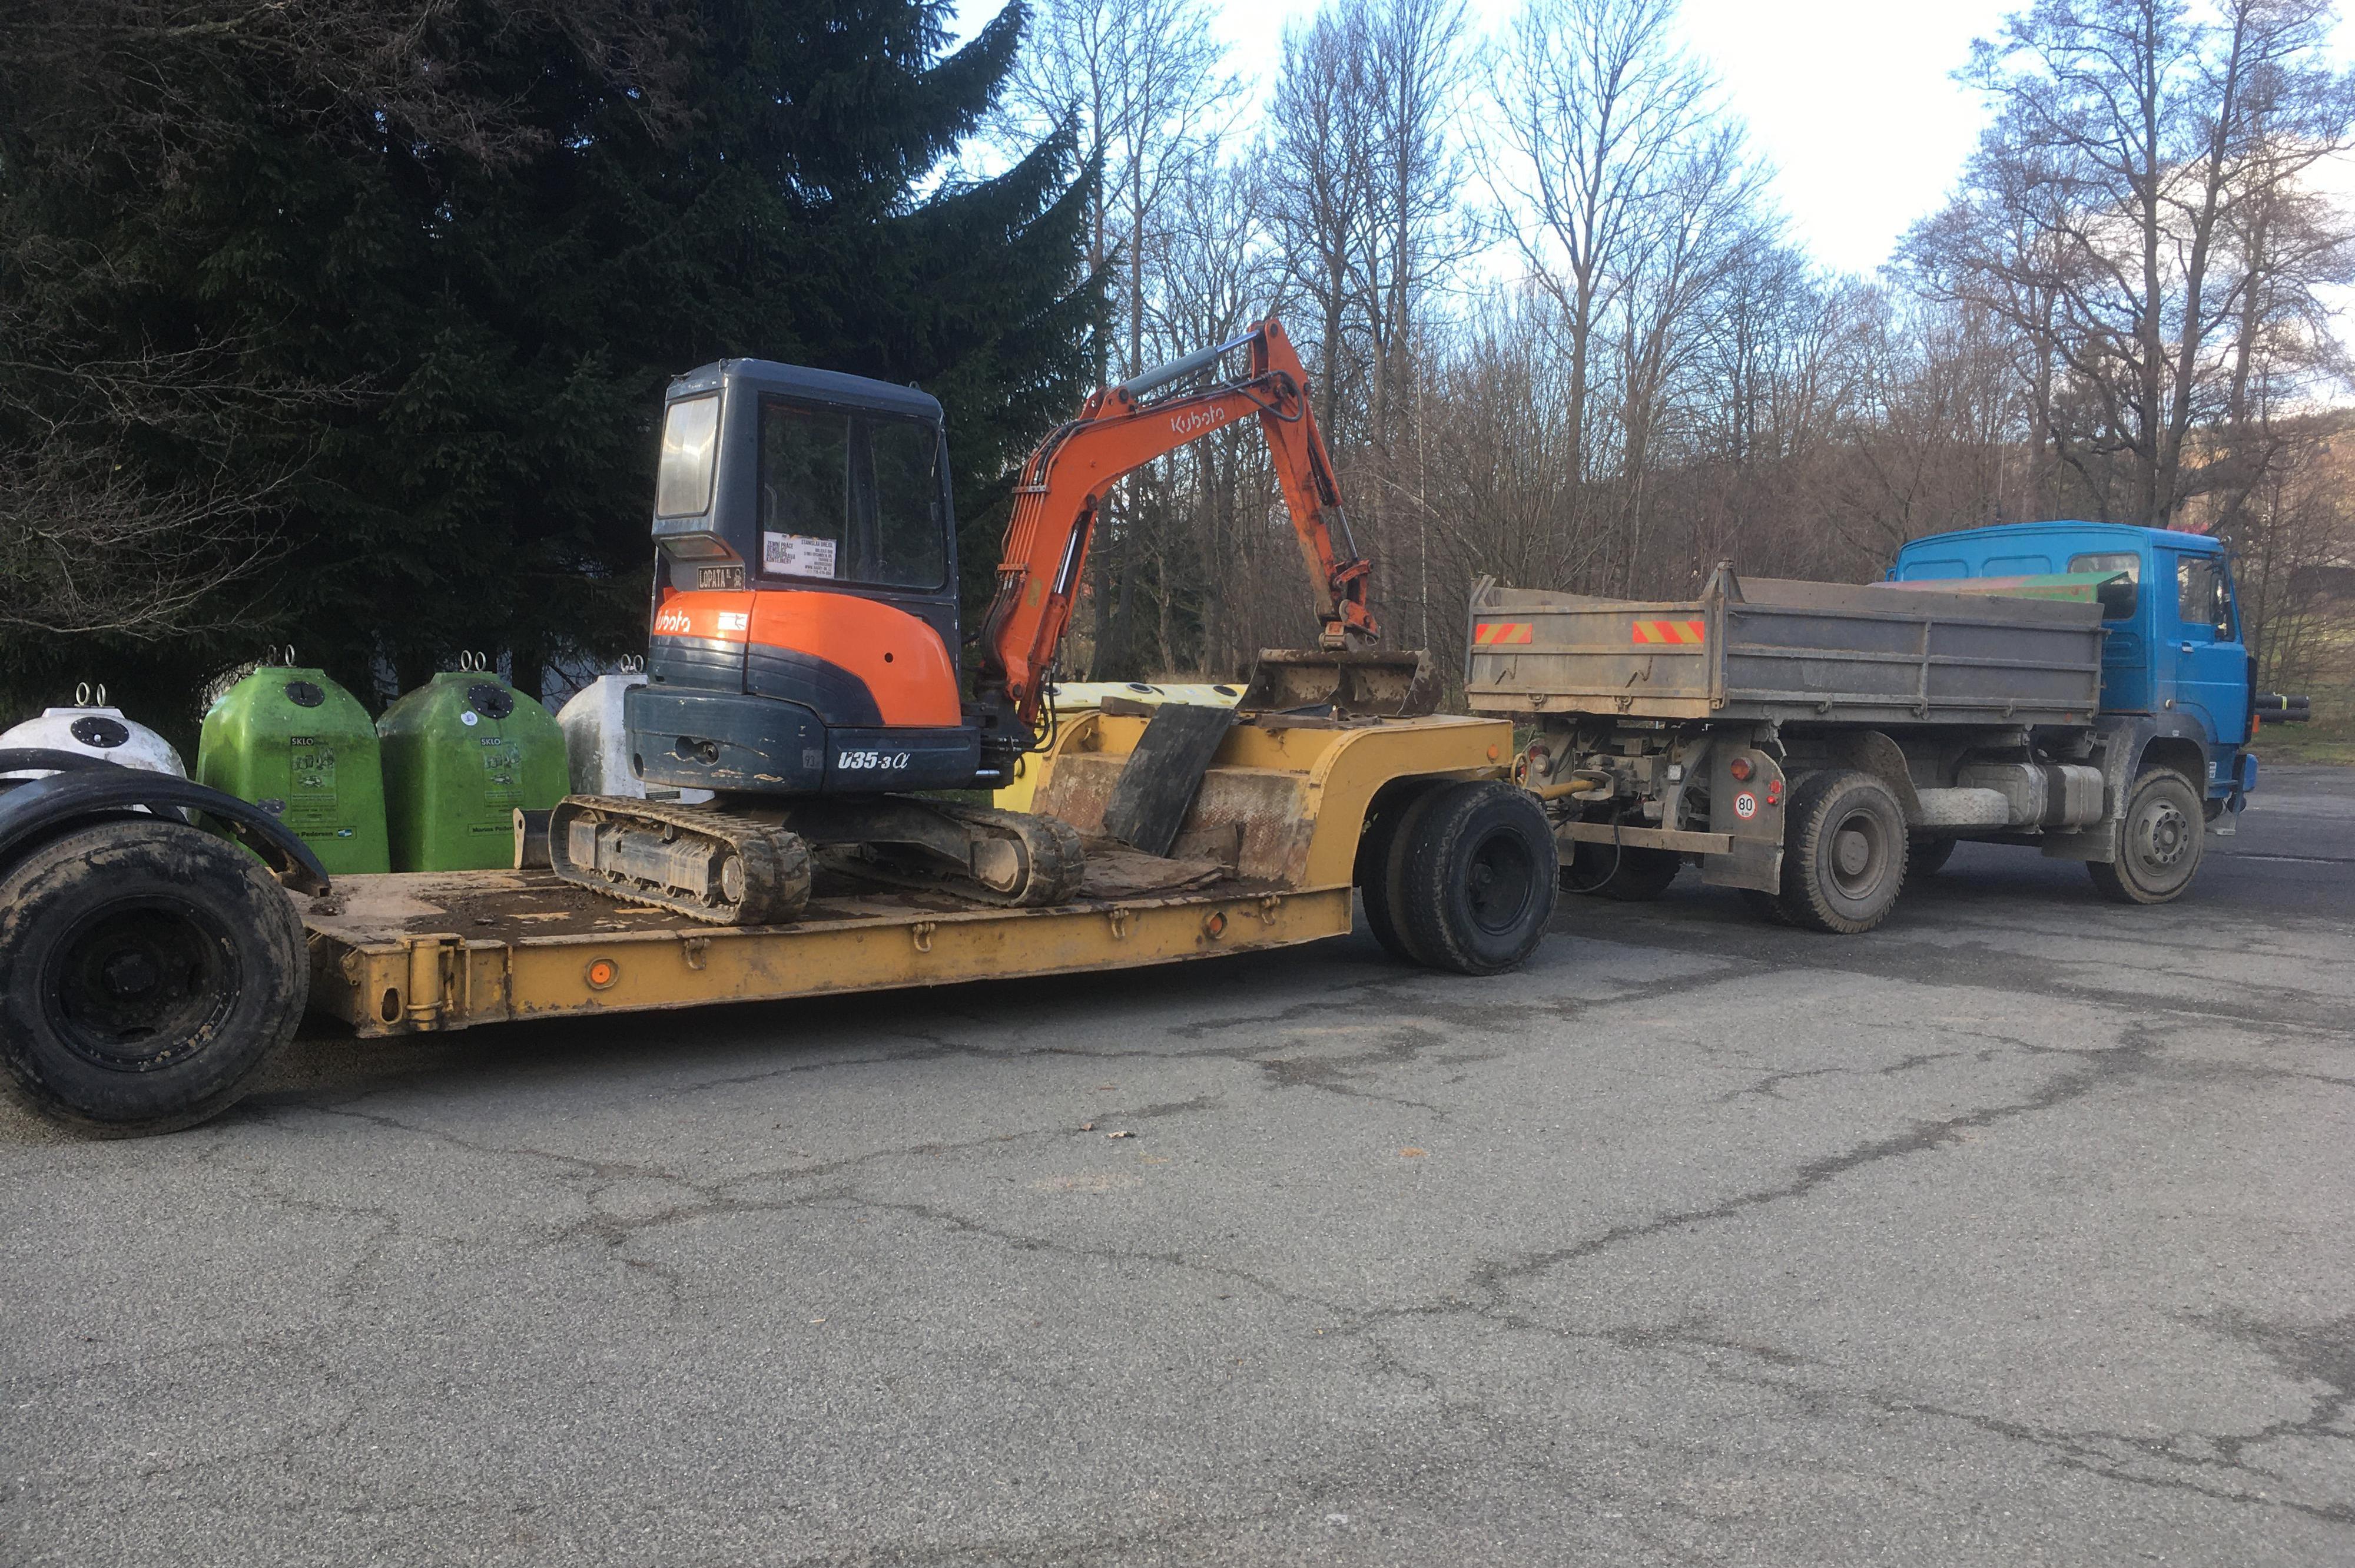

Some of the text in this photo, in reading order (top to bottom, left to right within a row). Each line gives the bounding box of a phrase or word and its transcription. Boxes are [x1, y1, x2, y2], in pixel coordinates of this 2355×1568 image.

[1170, 405, 1225, 434] Kubota
[699, 569, 725, 588] LOPATA
[292, 737, 314, 745] SKLO
[481, 738, 500, 746] SKLO
[1739, 798, 1752, 811] 80
